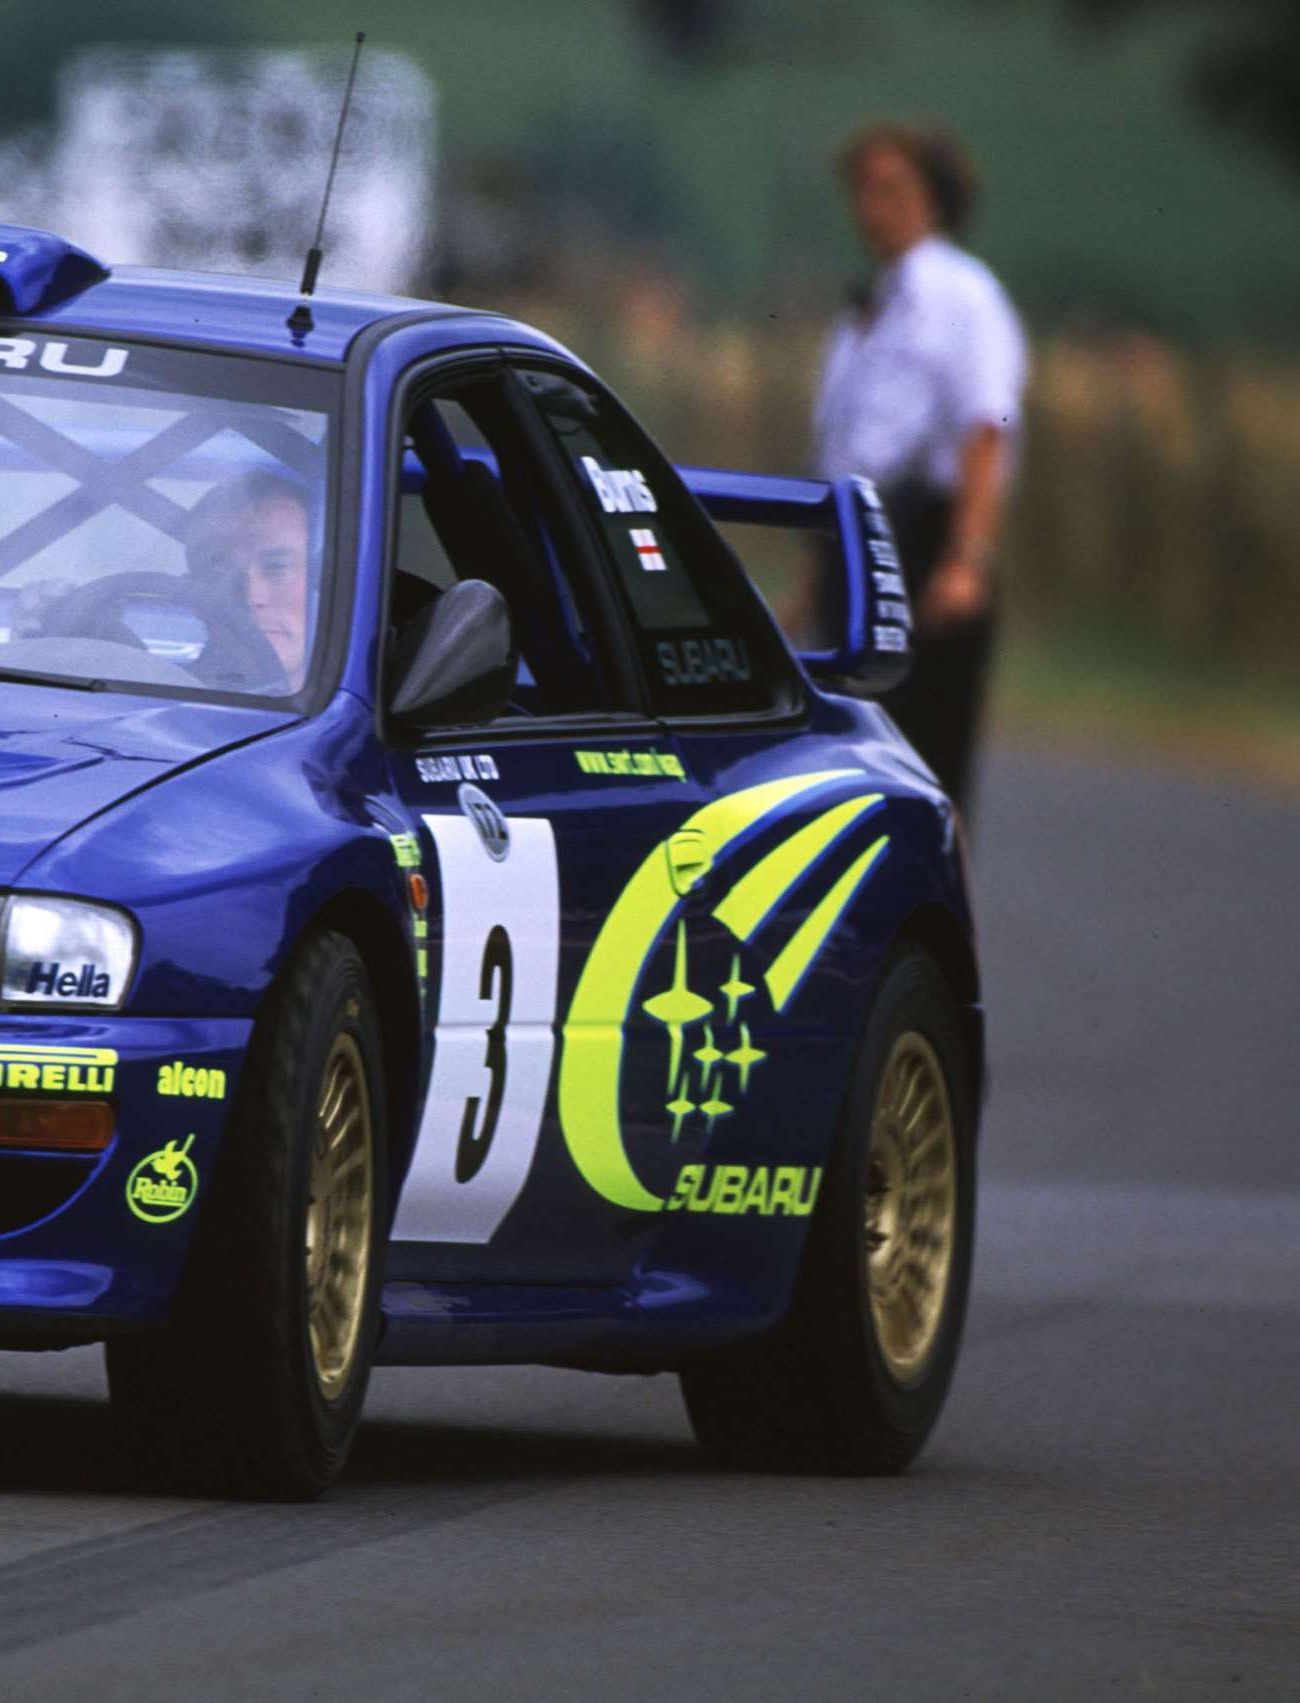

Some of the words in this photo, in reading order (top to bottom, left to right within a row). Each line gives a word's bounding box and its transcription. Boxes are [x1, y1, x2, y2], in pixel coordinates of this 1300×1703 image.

[656, 638, 750, 685] SUBARU
[26, 962, 111, 998] Hella
[454, 925, 513, 1184] 3
[157, 1061, 226, 1099] alcon
[666, 1164, 823, 1216] SUBARU
